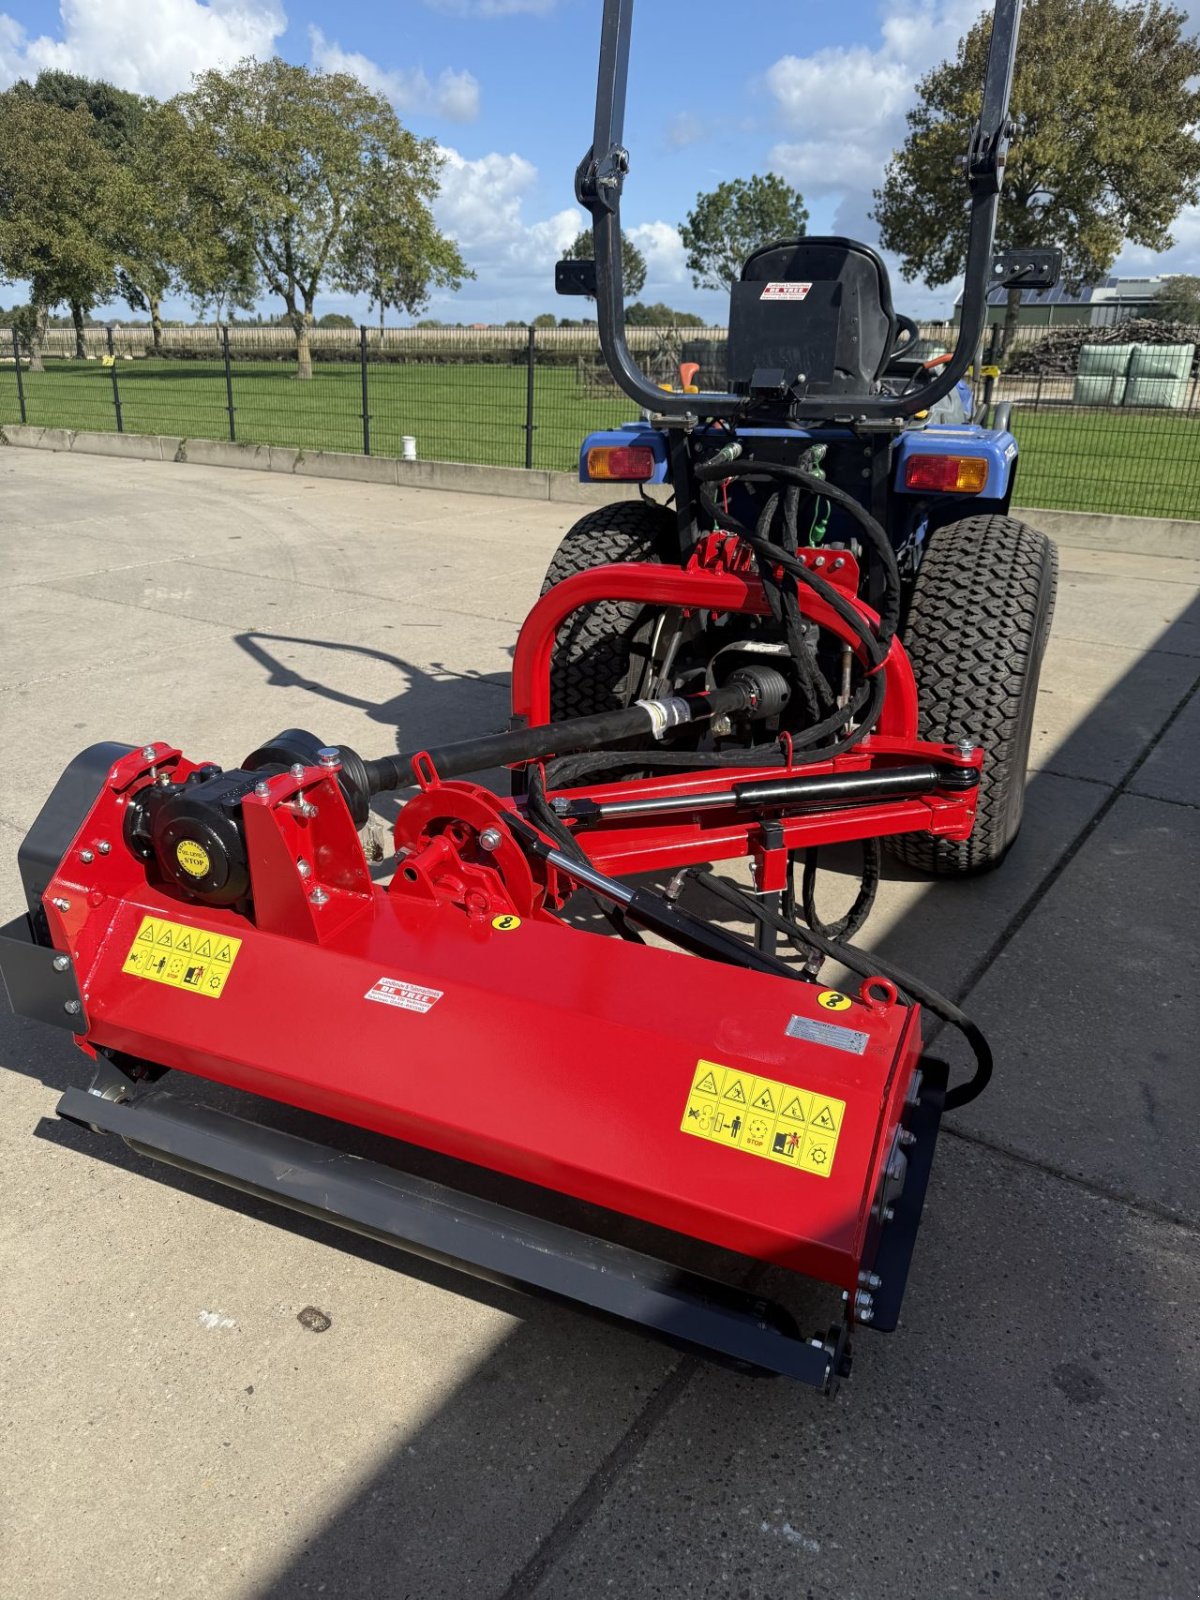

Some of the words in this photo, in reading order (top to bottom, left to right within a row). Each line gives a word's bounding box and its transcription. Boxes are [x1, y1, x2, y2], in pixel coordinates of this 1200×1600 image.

[184, 857, 204, 866] STOP
[380, 985, 396, 994] DE
[400, 988, 429, 1002] VREE
[746, 1138, 763, 1147] STOP
